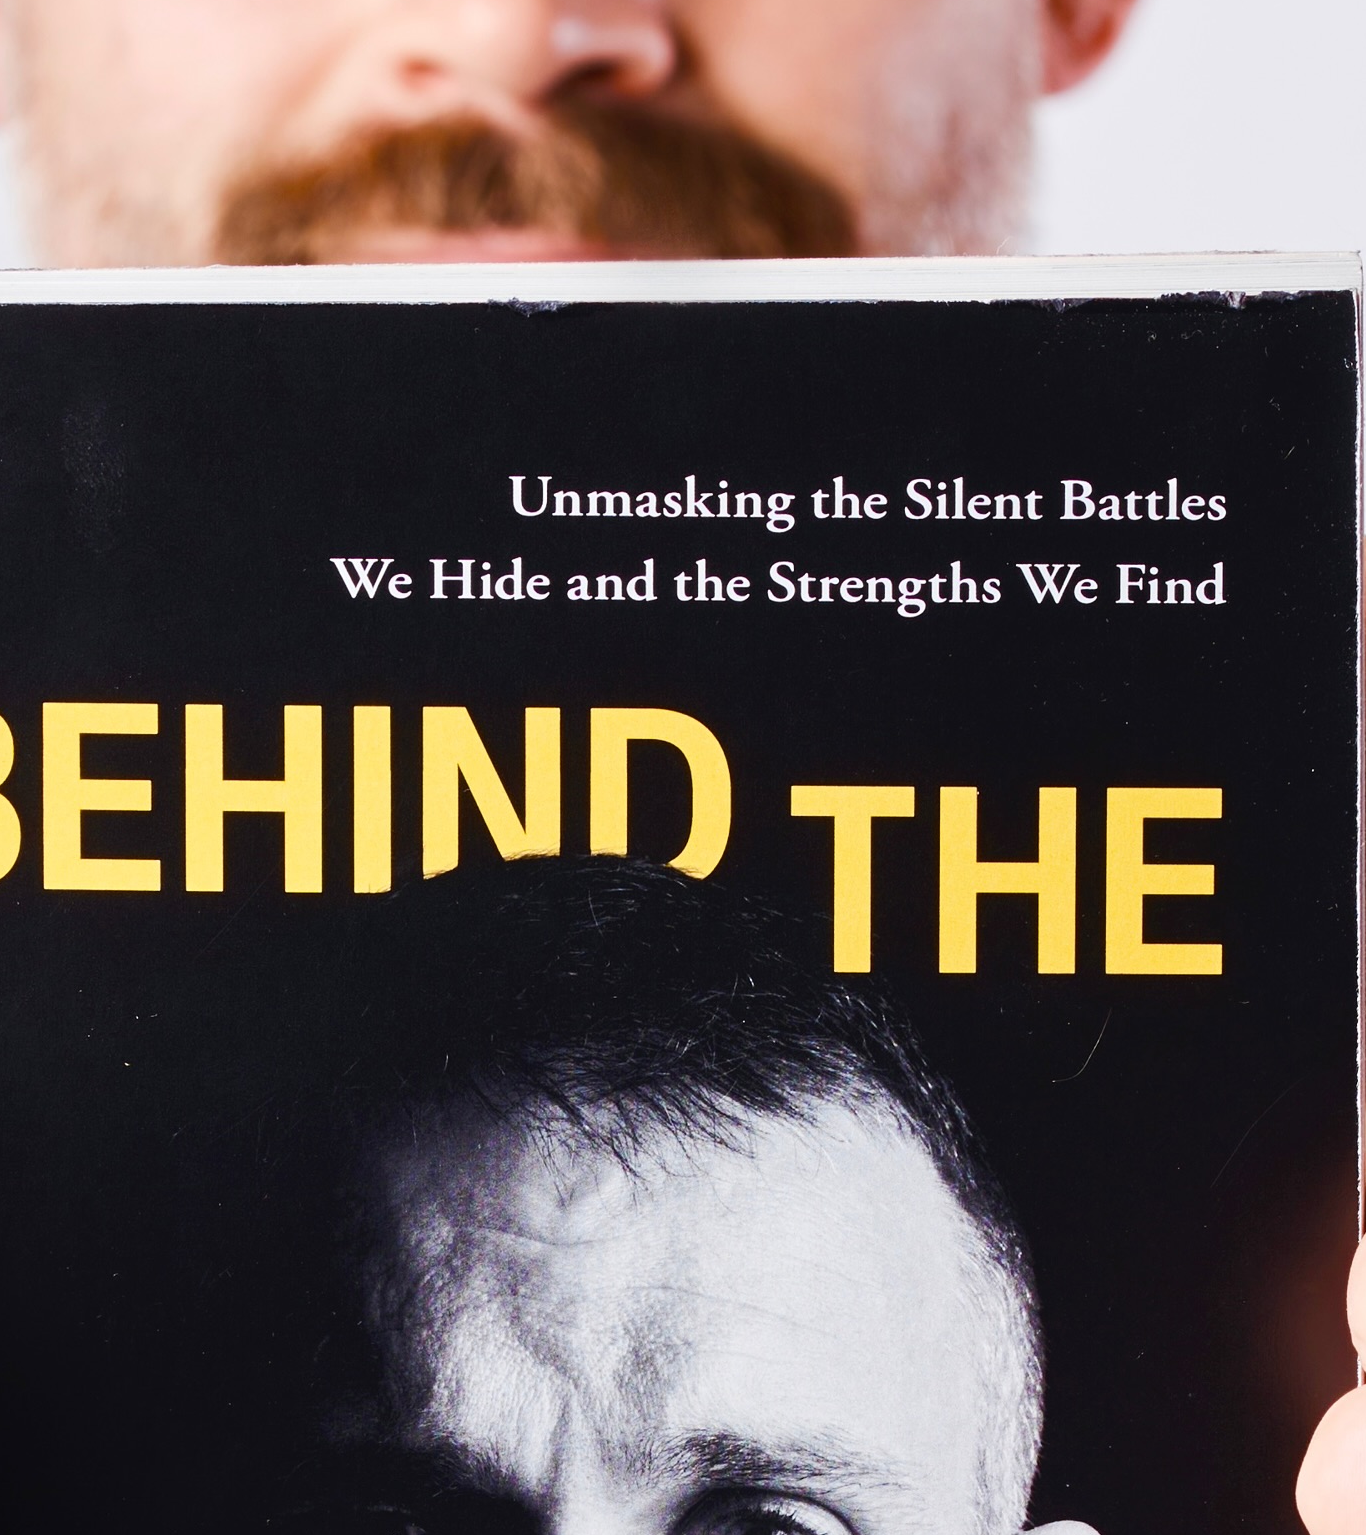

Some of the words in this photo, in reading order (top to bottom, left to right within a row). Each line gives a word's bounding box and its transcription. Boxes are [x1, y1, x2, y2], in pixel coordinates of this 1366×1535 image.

[508, 474, 796, 534] Unmasking
[810, 475, 888, 520] the
[904, 476, 1044, 521] Silent
[1059, 477, 1227, 521] Battles
[329, 557, 413, 600] We
[428, 556, 551, 601] Hide
[566, 557, 658, 602] and
[673, 558, 751, 602] the
[767, 560, 1002, 618] Strengths
[1015, 563, 1099, 605] We
[1115, 561, 1227, 606] Find
[790, 785, 1223, 975] THE
